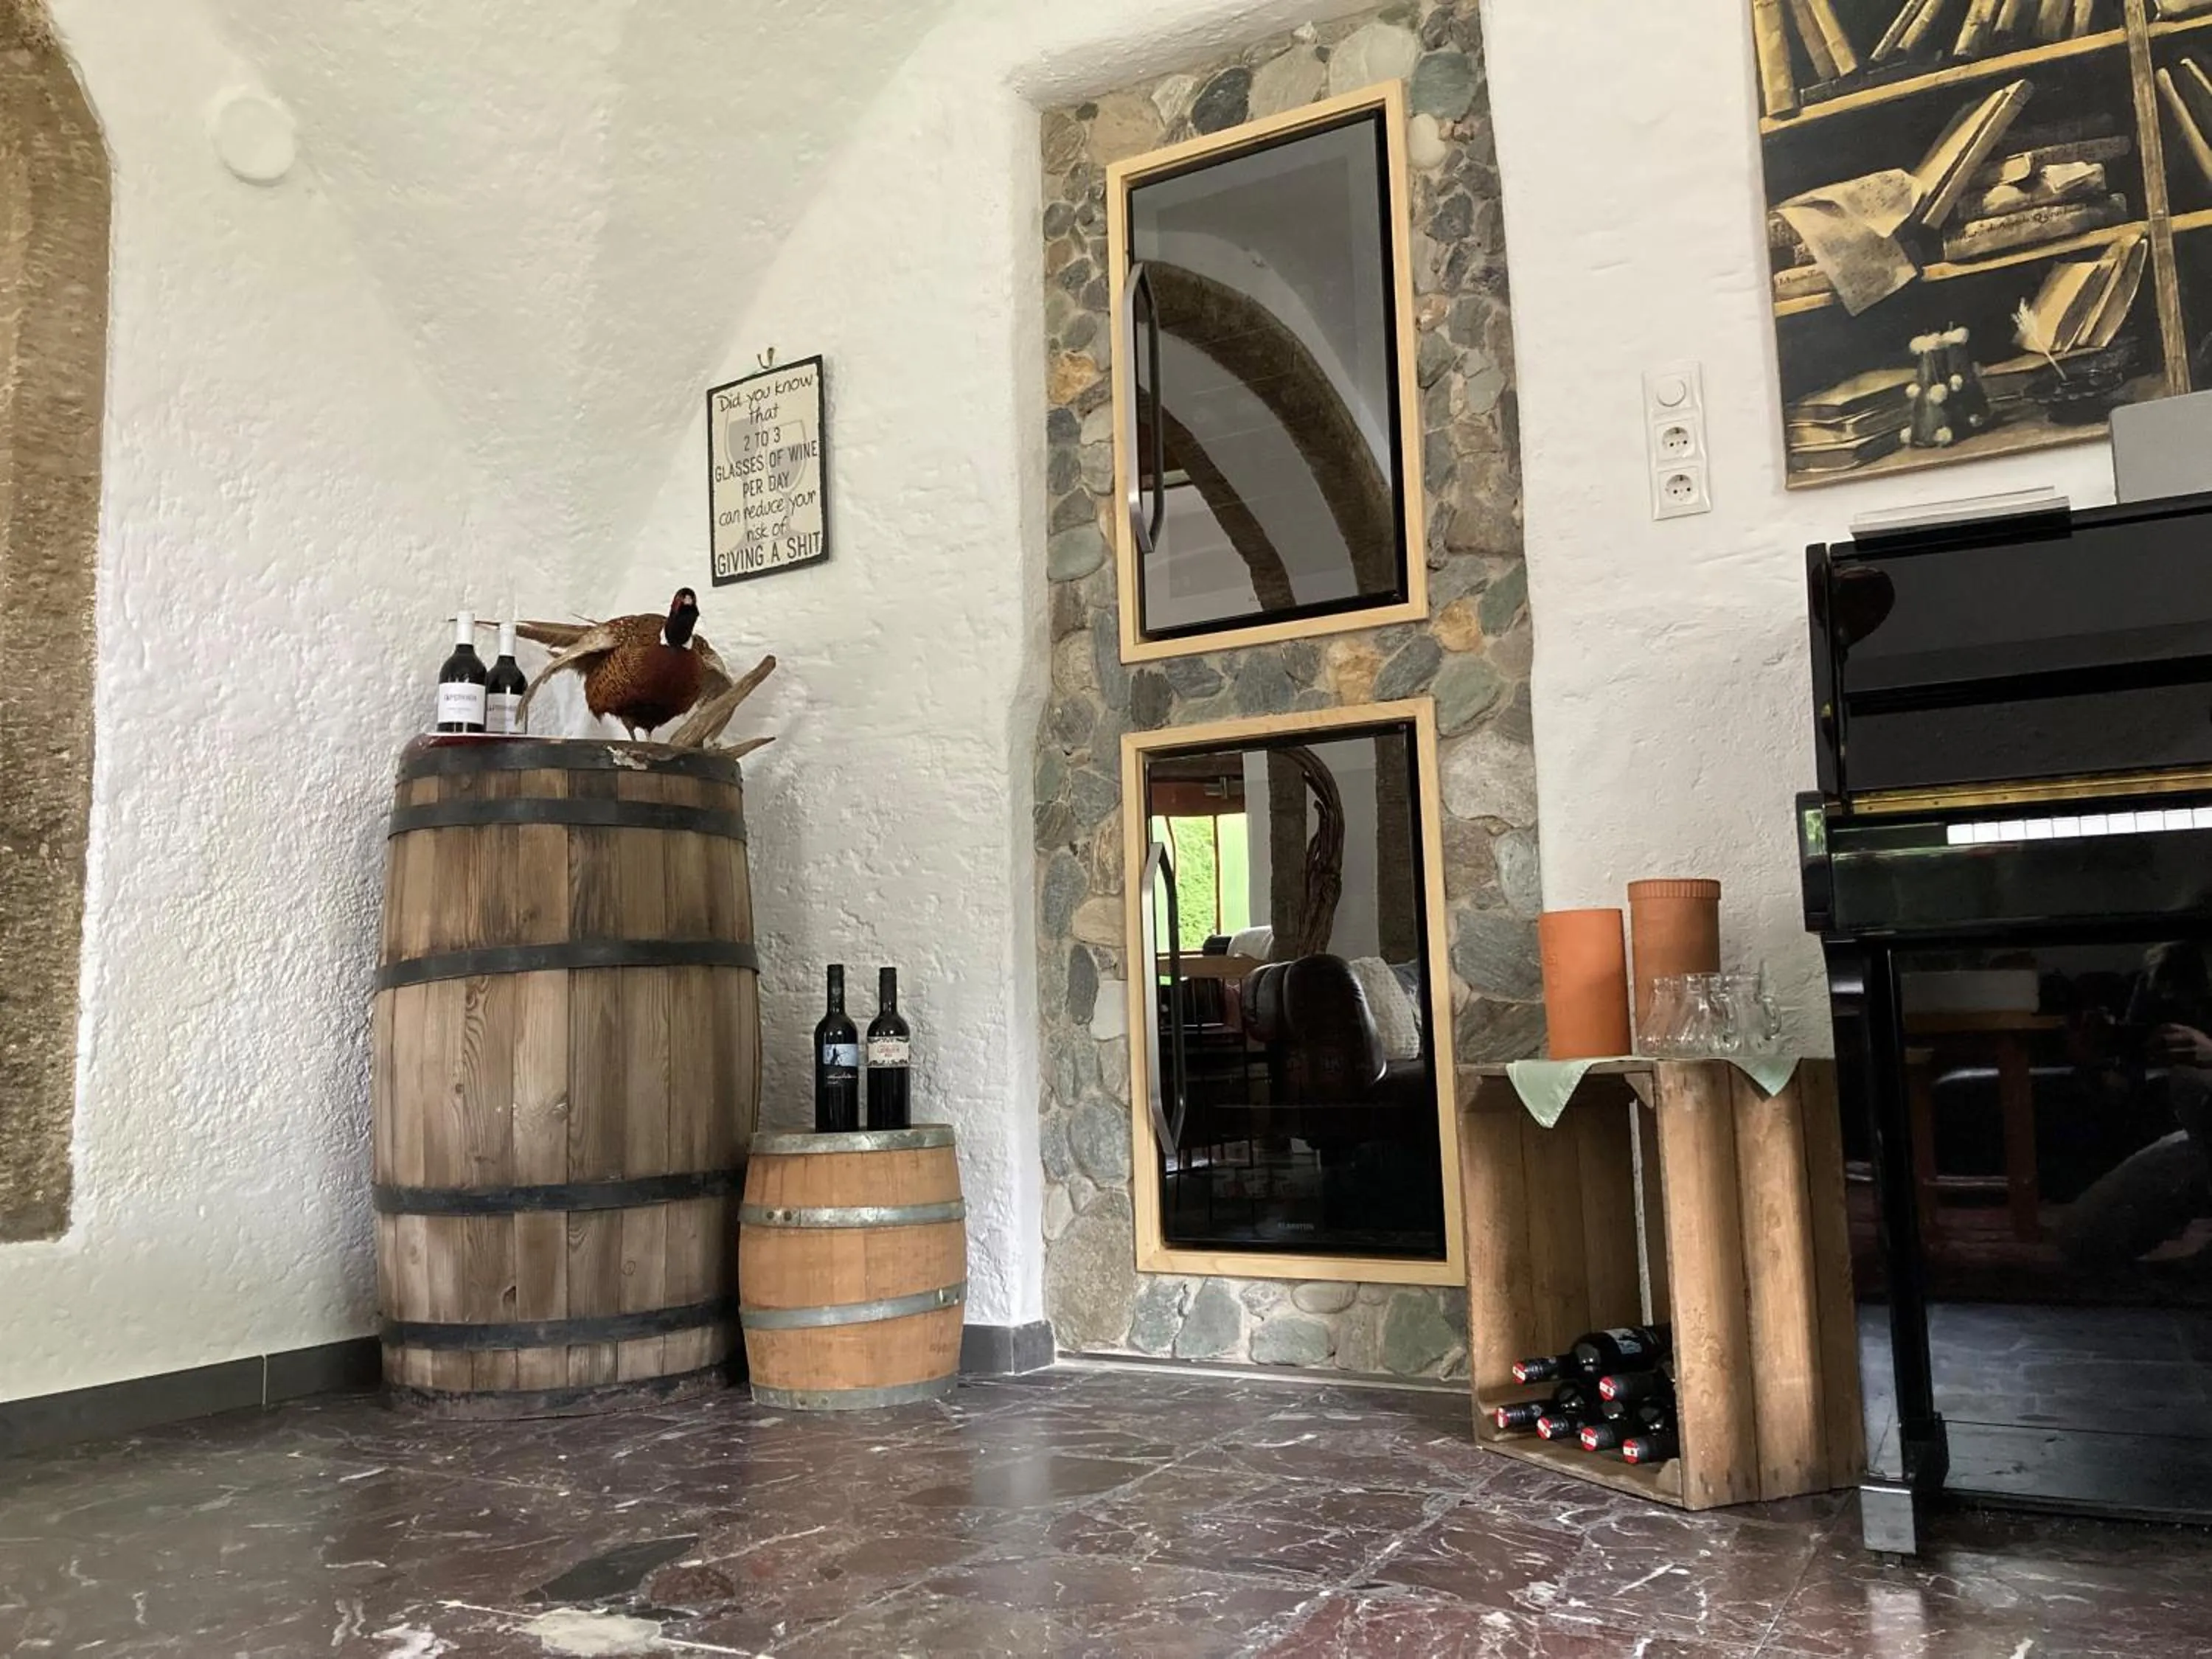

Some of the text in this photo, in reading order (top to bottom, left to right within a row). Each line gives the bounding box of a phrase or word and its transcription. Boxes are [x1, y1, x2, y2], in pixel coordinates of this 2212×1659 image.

[716, 374, 813, 412] Did you know
[749, 403, 779, 425] that
[743, 426, 781, 452] 2 TO 3
[714, 440, 818, 482] GLASSES OF WINE
[743, 471, 790, 499] PER DAY
[719, 489, 816, 526] can reduce your
[746, 515, 789, 542] risk of
[717, 531, 820, 575] GIVING A SHIT
